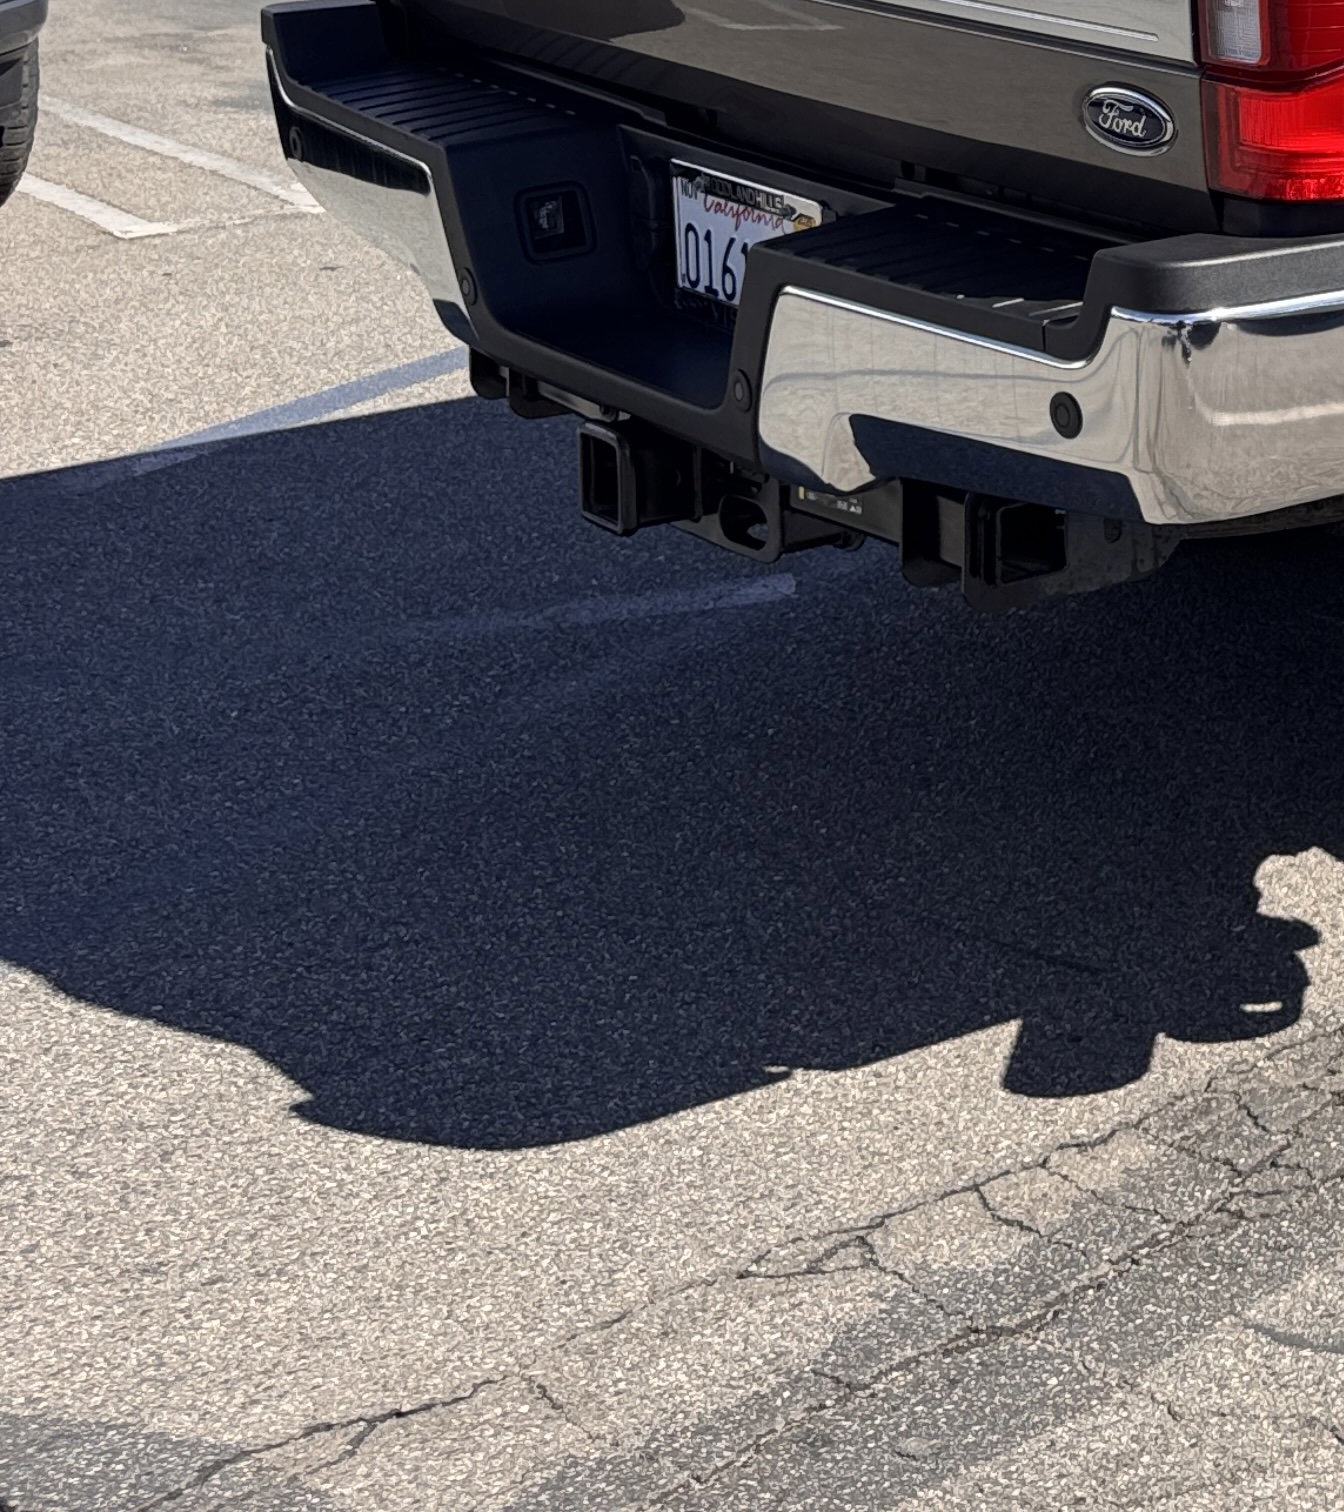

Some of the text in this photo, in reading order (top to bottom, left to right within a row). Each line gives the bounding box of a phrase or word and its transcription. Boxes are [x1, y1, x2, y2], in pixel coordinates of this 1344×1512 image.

[1098, 98, 1147, 138] Ford
[703, 194, 786, 234] California
[684, 222, 749, 301] 016
